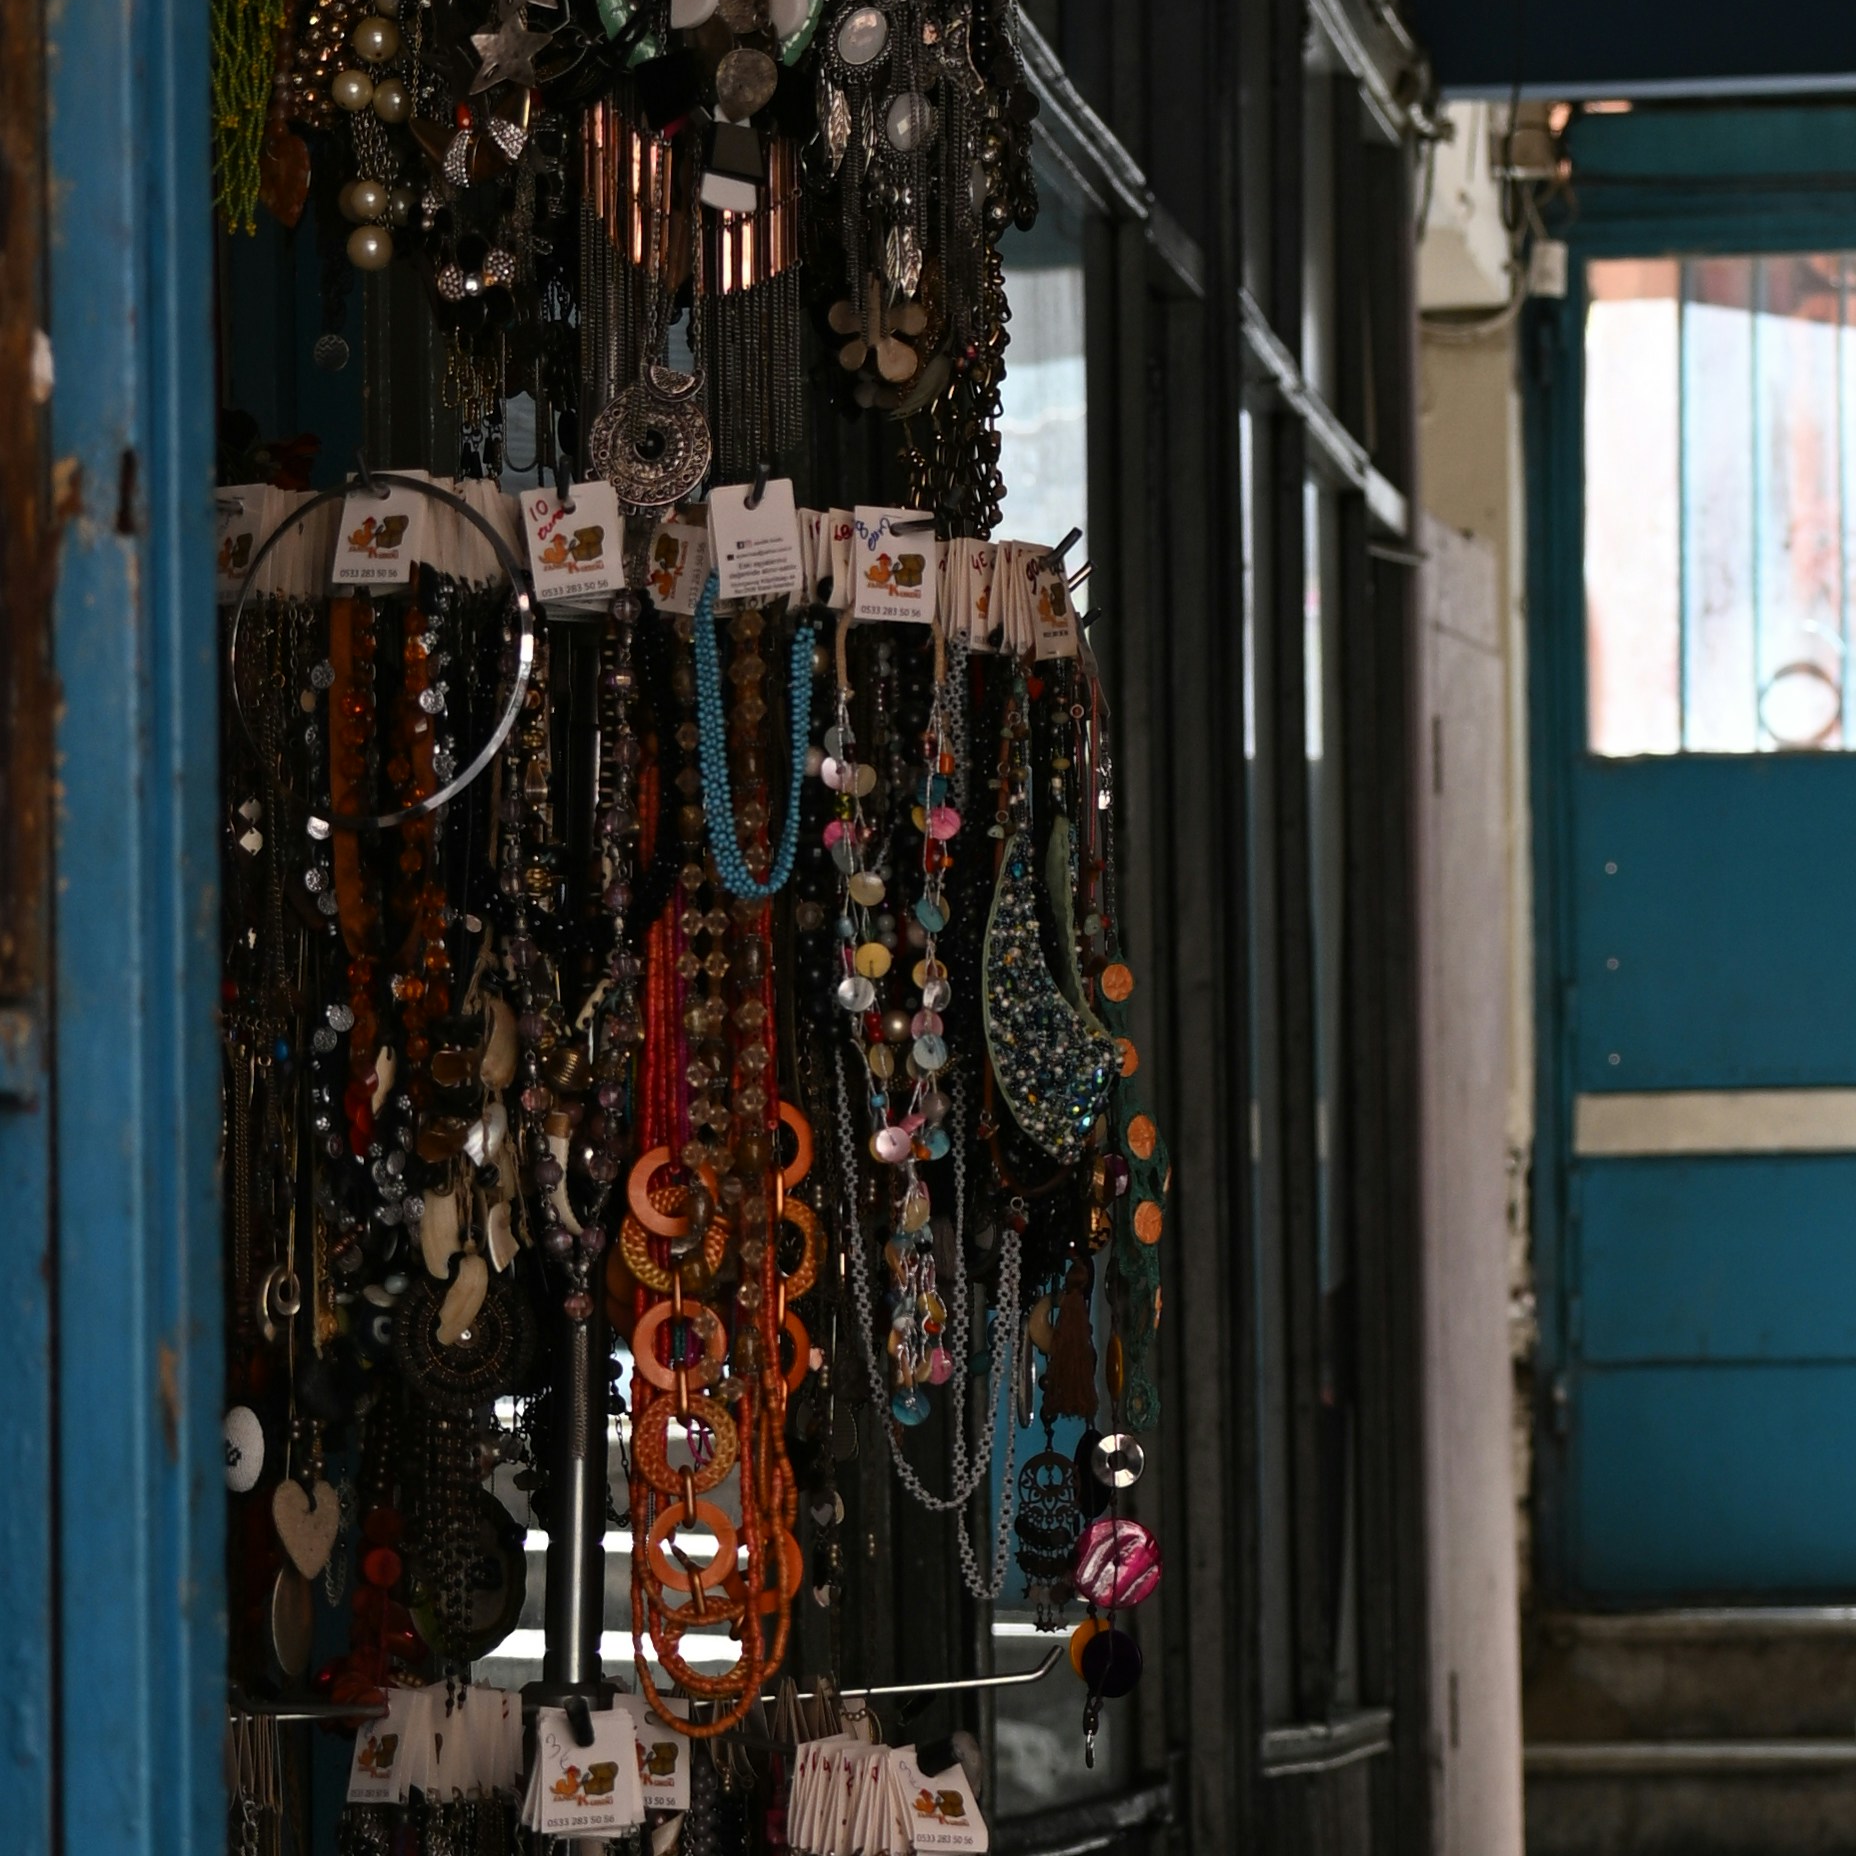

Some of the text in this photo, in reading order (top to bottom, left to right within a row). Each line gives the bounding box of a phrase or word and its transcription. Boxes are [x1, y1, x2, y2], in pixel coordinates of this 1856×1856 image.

[530, 500, 548, 521] 10
[340, 569, 397, 577] 0533 283 50 56
[541, 580, 608, 597] 0533 283 50 56
[861, 605, 920, 617] 0533 283 50 56
[654, 1797, 664, 1805] 50
[666, 1797, 676, 1805] 56
[547, 1814, 614, 1827] 0533 283 50 56
[916, 1834, 974, 1844] 0533 283 50 56
